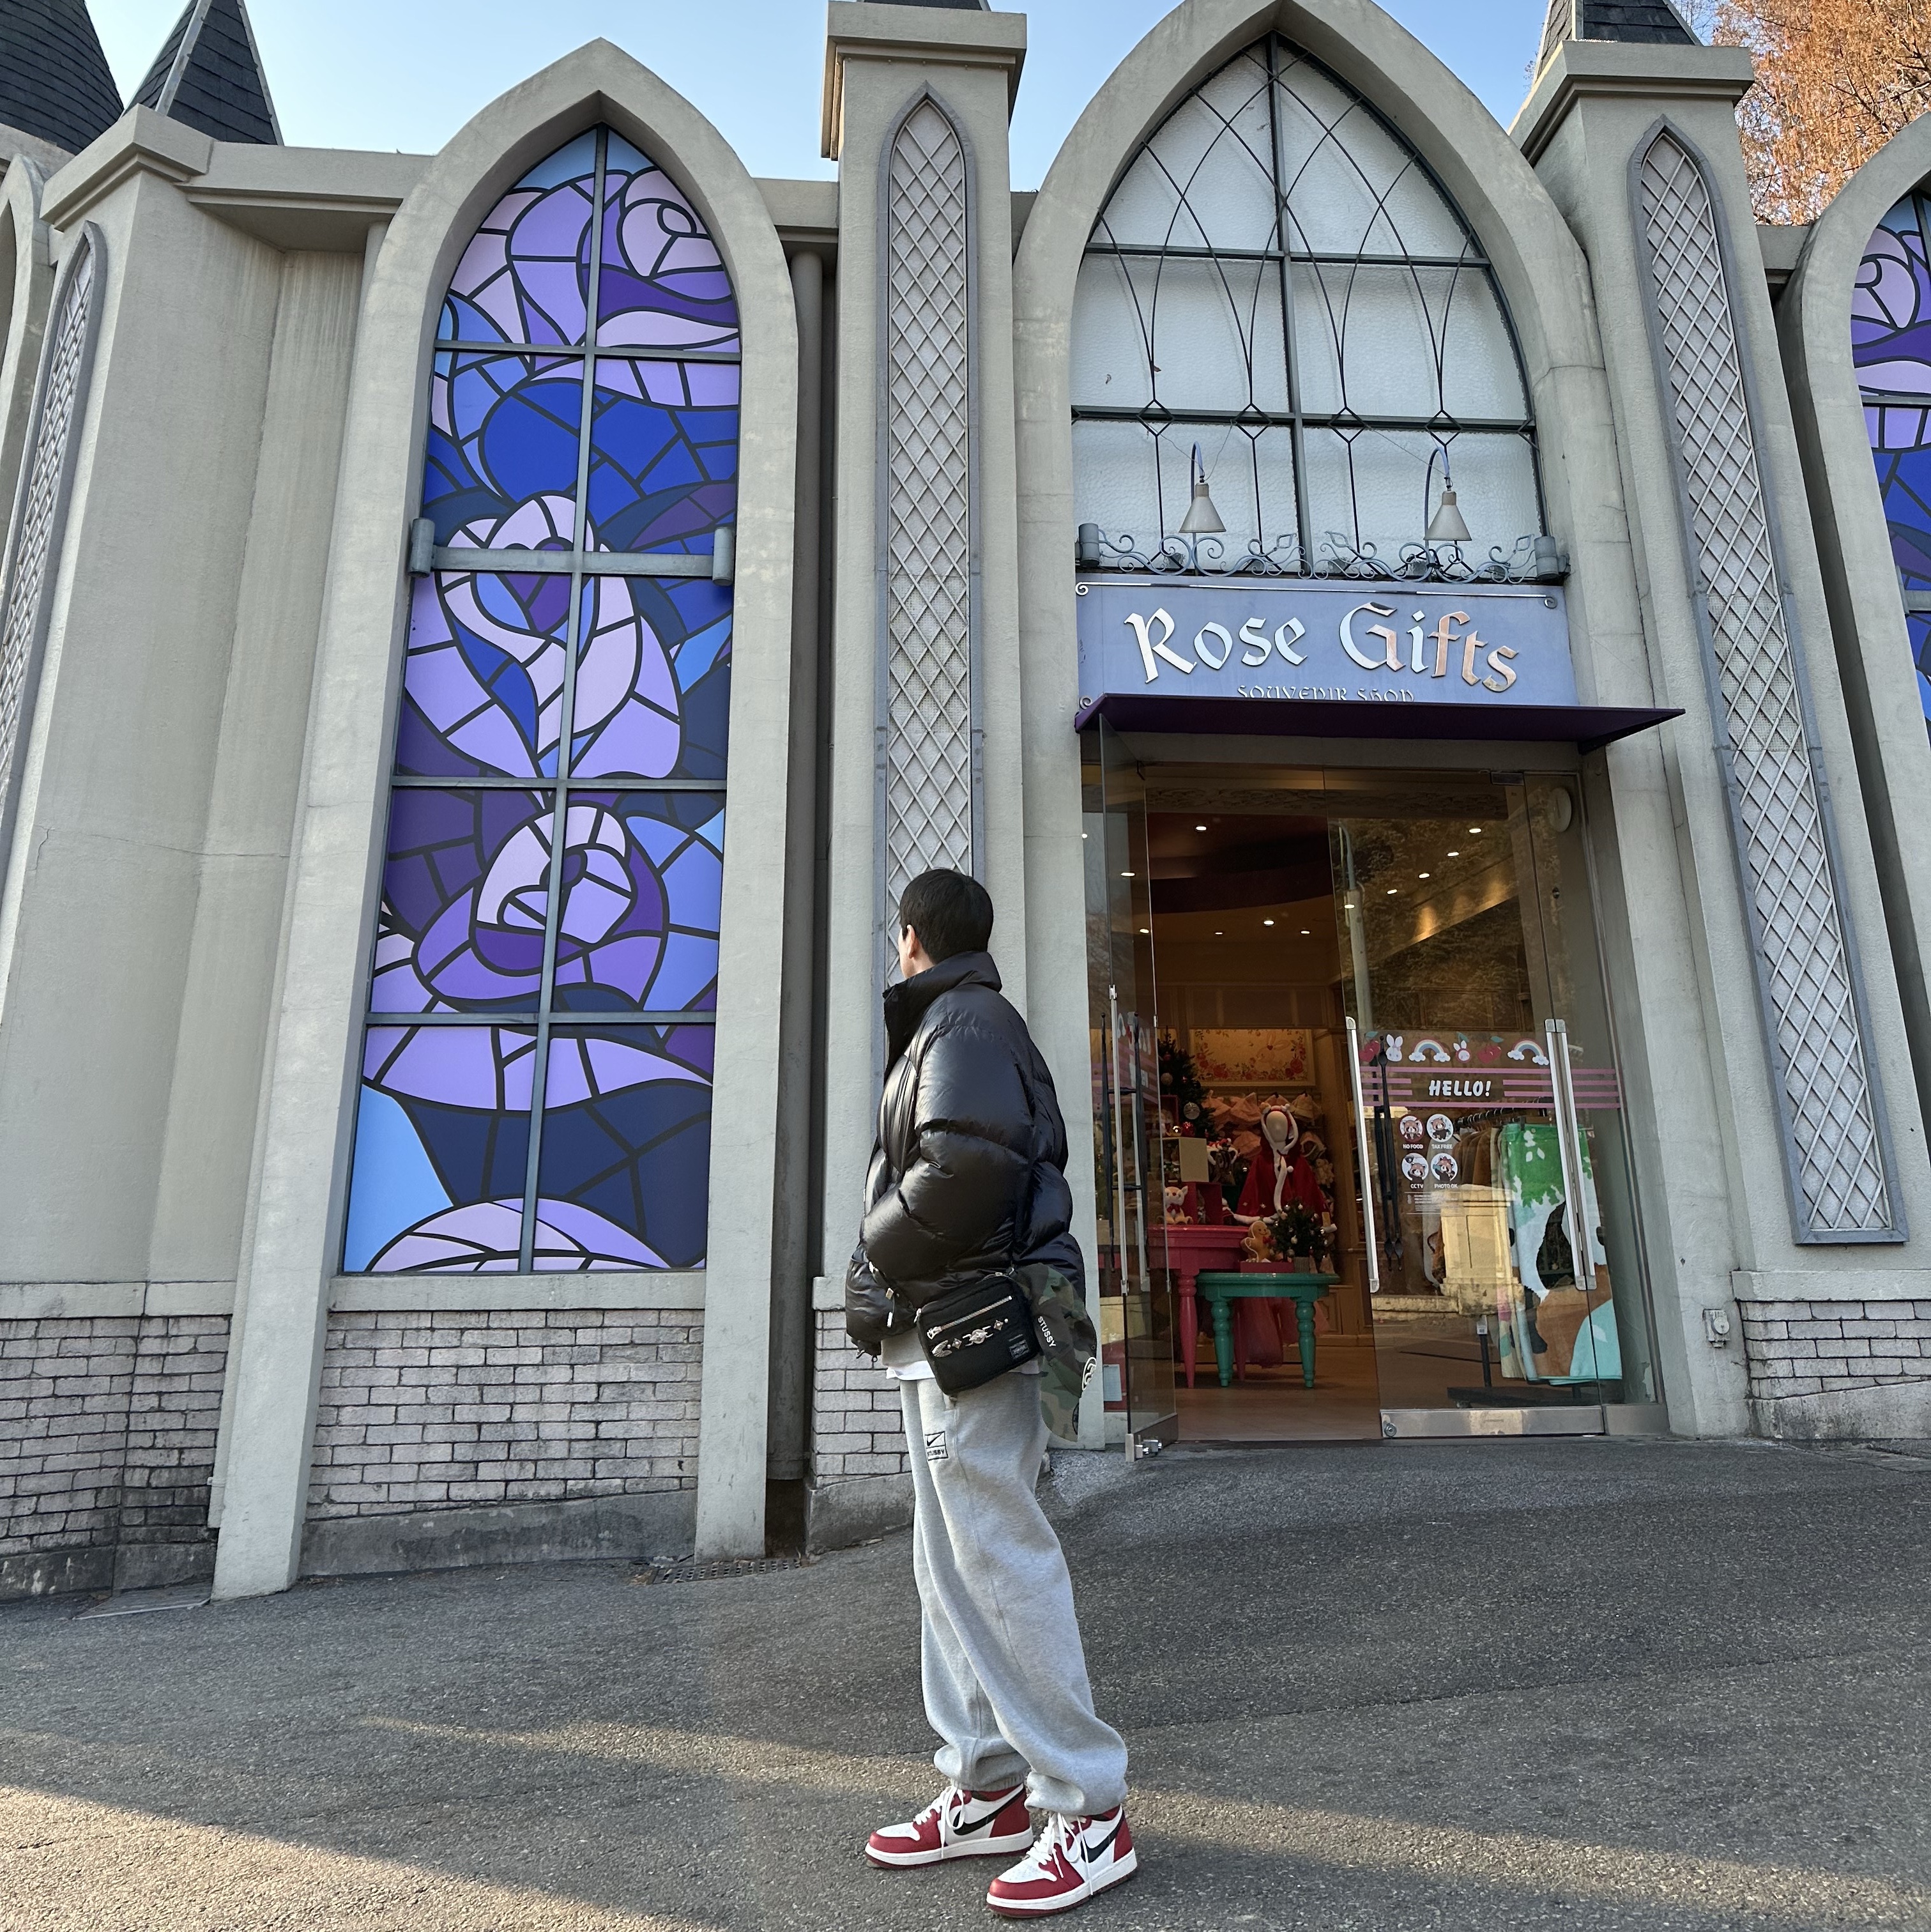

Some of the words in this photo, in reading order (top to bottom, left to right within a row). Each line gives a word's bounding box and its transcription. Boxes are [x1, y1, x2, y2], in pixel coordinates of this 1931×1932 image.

[1124, 608, 1308, 684] Rose
[1339, 602, 1519, 693] Gifts
[1428, 1080, 1492, 1097] HELLO!
[1037, 1315, 1057, 1347] STUSSY
